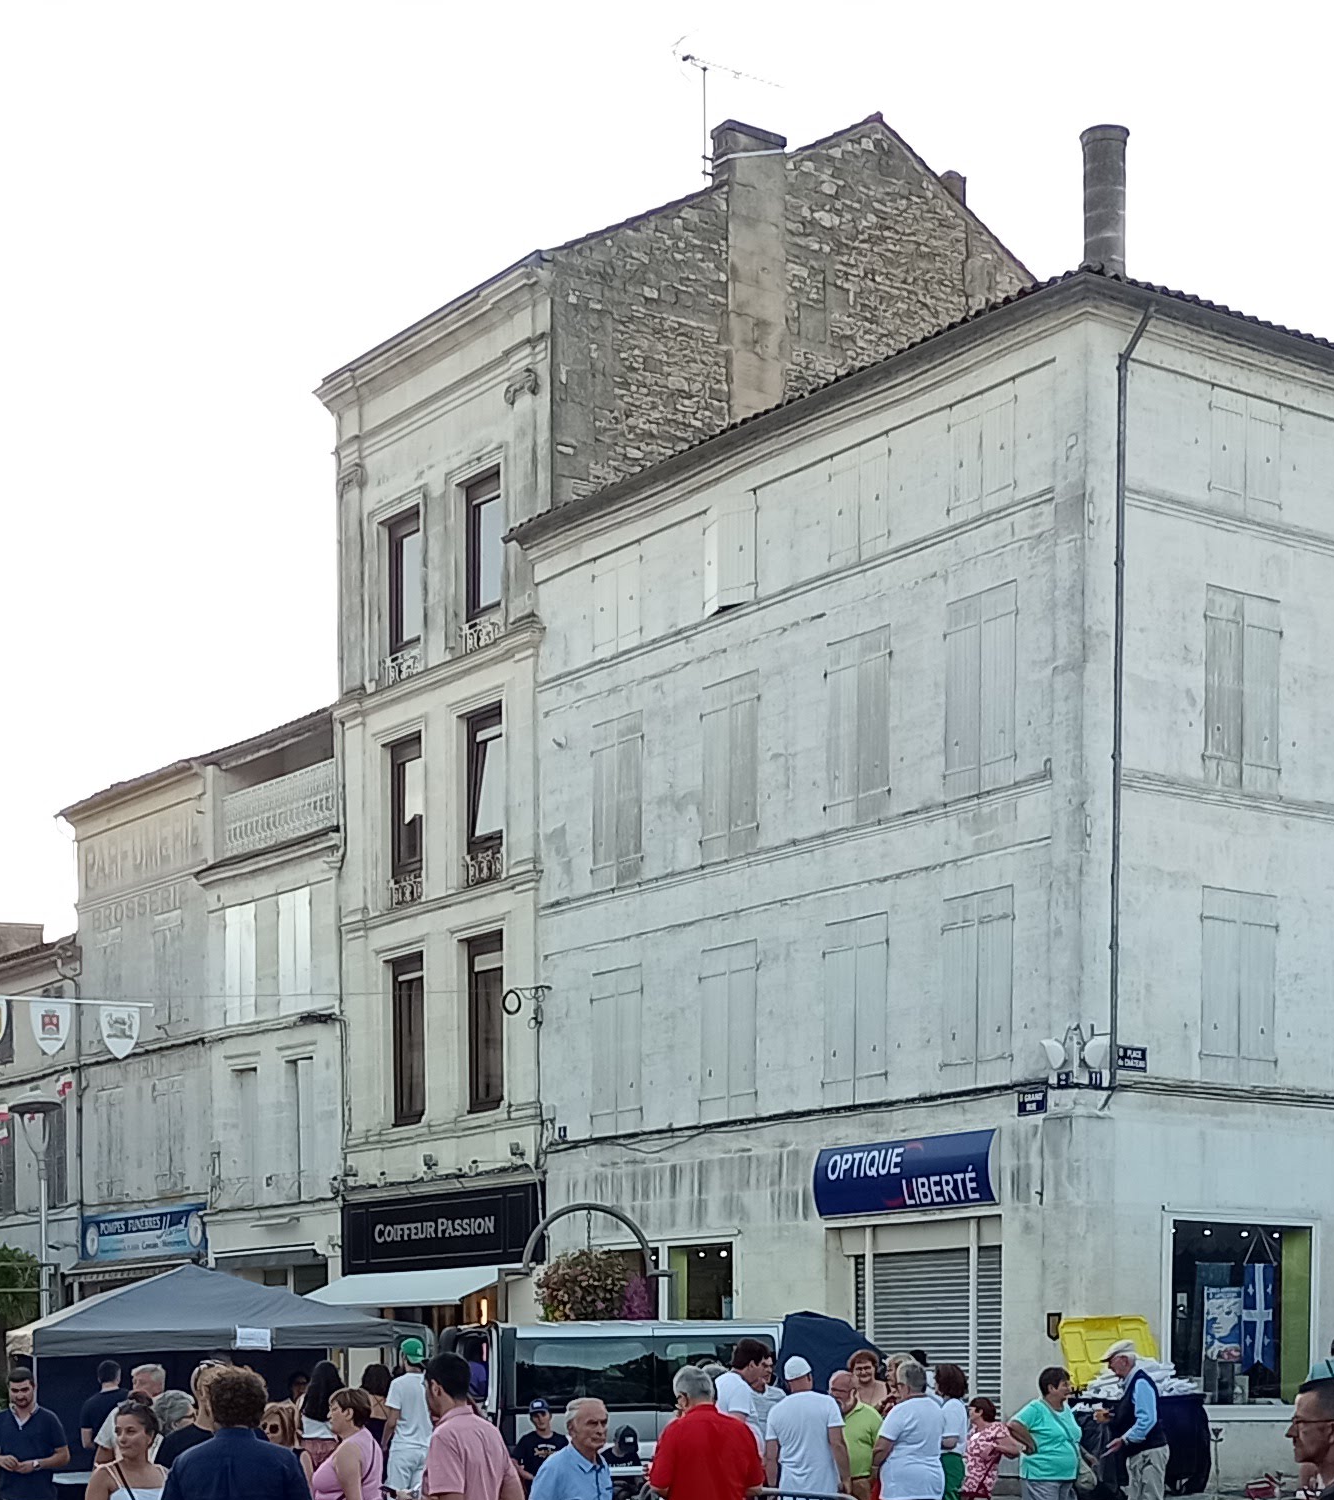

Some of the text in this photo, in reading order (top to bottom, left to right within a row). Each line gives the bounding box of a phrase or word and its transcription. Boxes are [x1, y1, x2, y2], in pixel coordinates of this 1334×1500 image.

[827, 1147, 905, 1181] OPTIQUE
[901, 1165, 980, 1206] LIBERTÉ
[99, 1220, 126, 1235] POMPES
[374, 1215, 495, 1244] COIFFEUR PASSION
